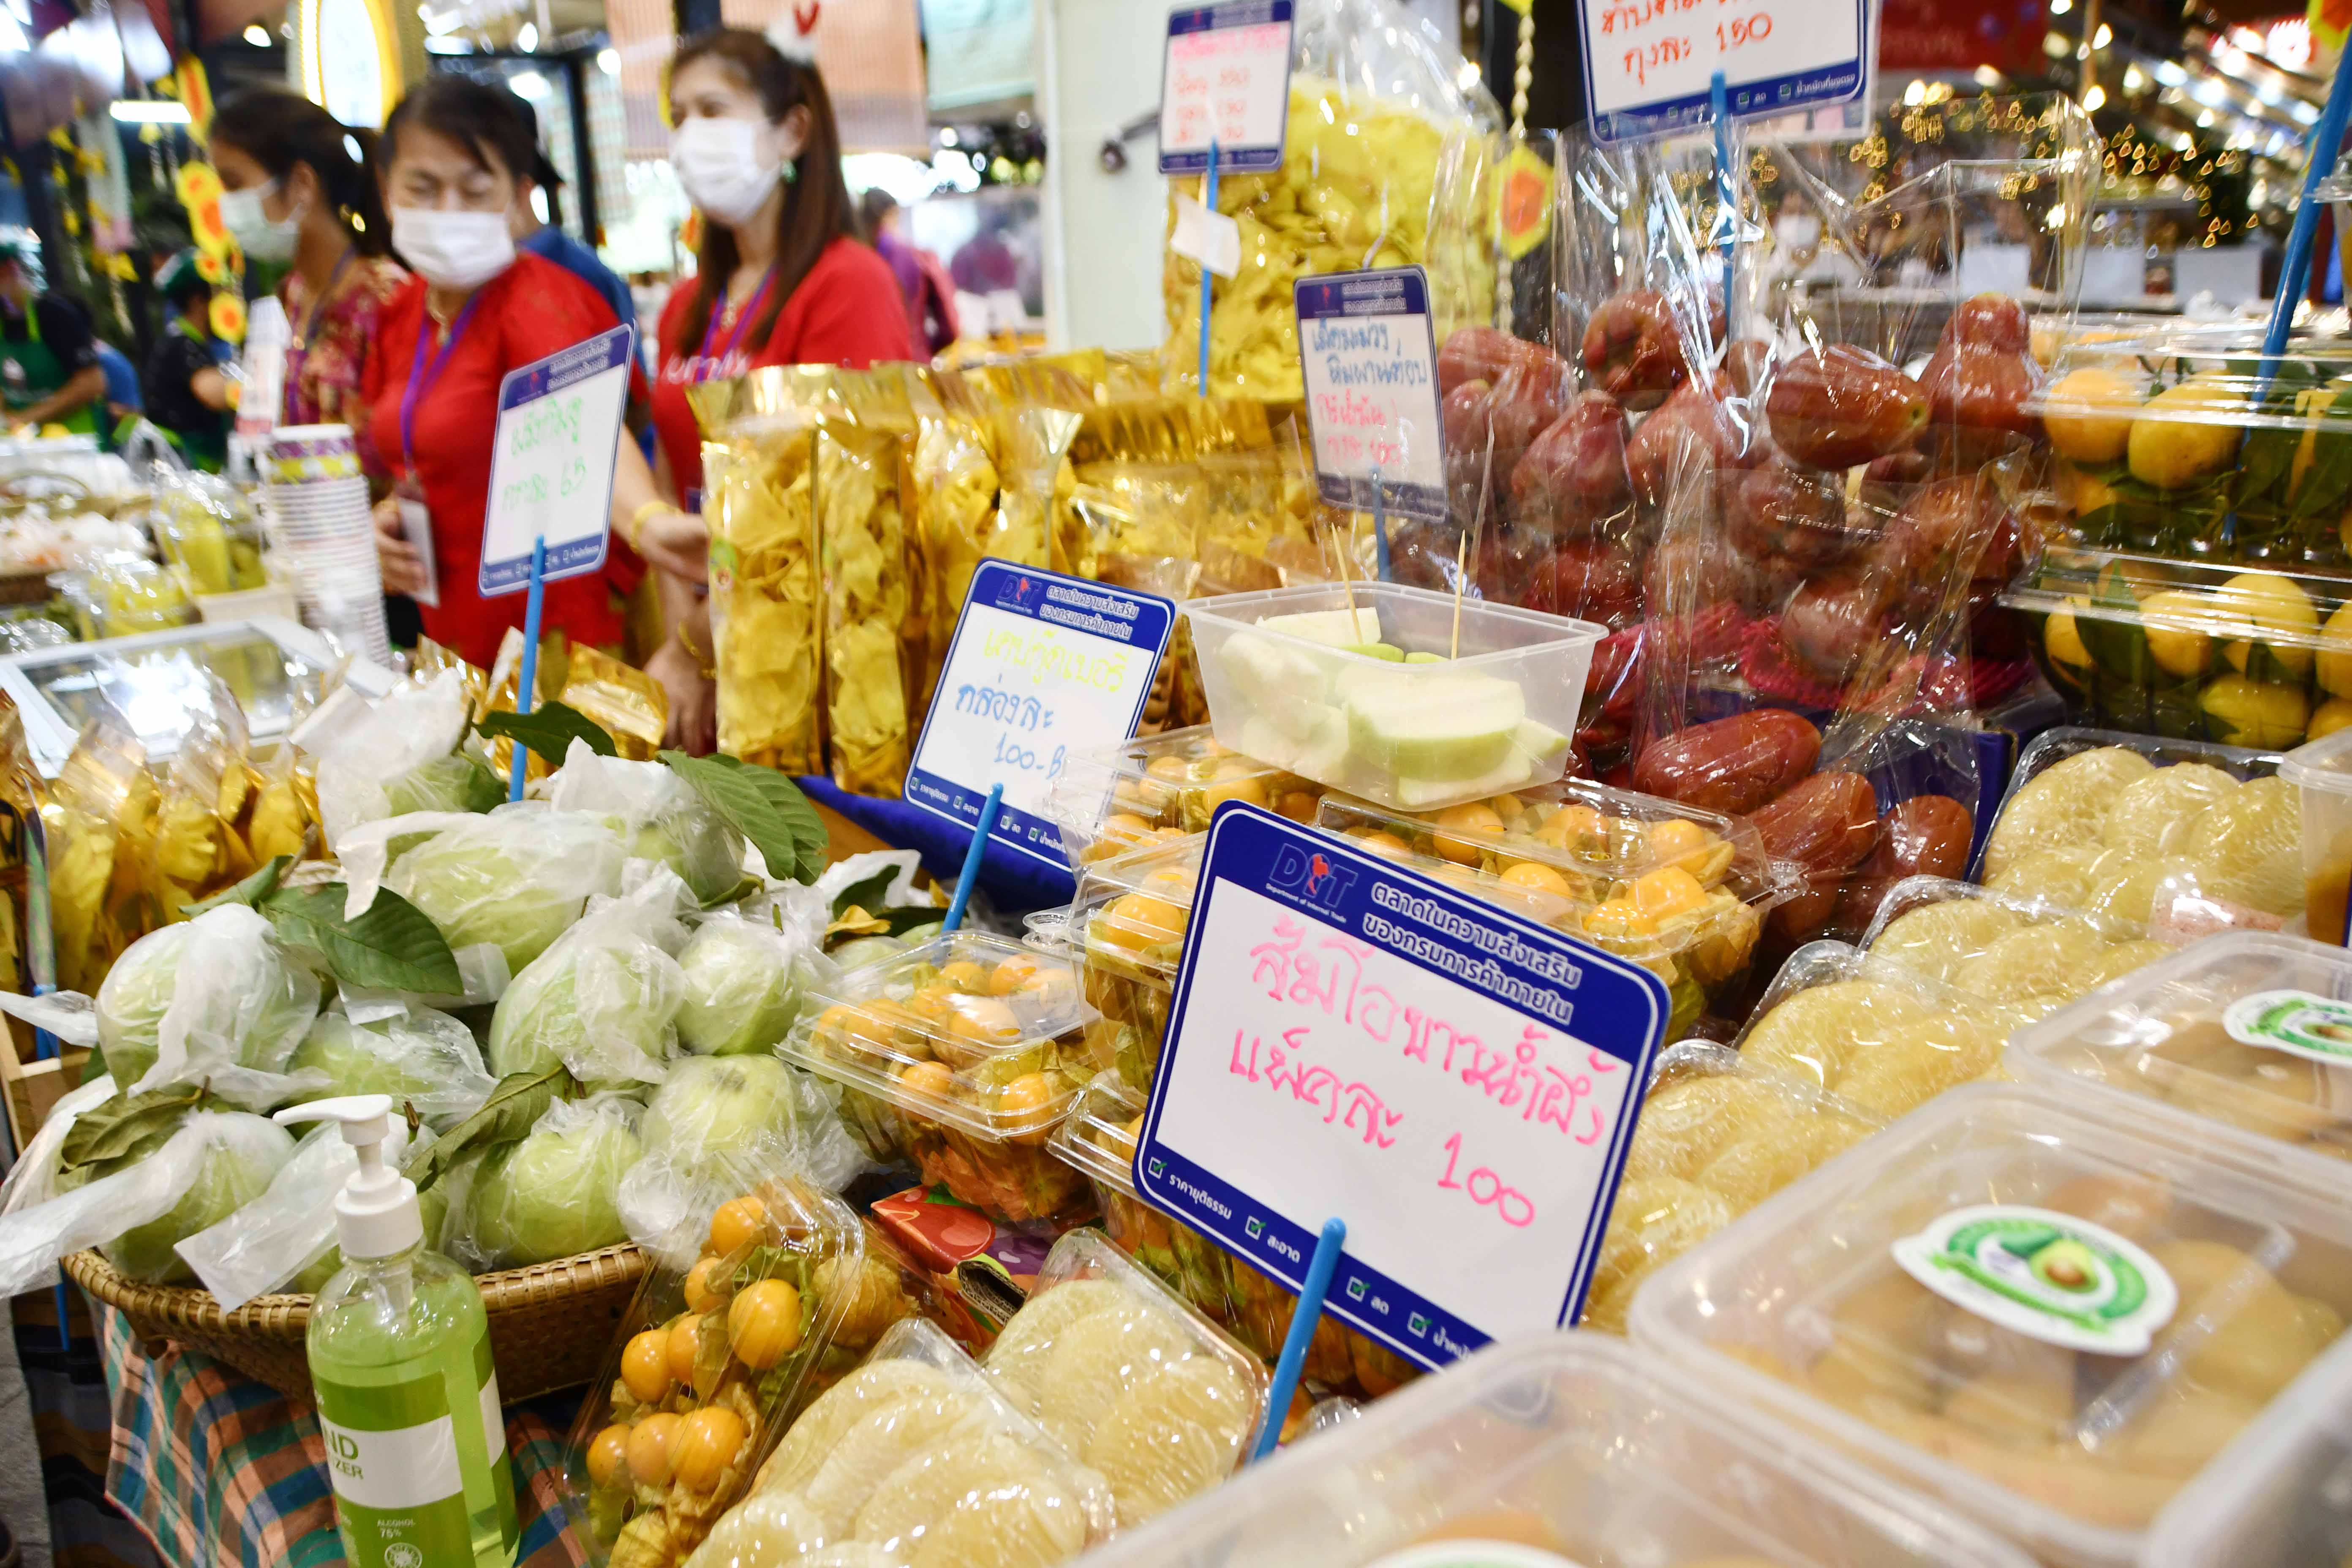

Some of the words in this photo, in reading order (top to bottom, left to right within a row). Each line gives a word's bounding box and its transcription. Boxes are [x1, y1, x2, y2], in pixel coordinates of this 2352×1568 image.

[1716, 12, 1772, 52] 150
[1039, 604, 1133, 641] ของกรมการค้าภายใน
[1046, 585, 1140, 621] ตลาดในความส่งเสริม
[955, 672, 1054, 731] กล่องละ
[1371, 882, 1583, 990] ตลาดในความส่งเสริม
[1362, 912, 1574, 1026] ของกรมการค้าภายใน
[1169, 1173, 1232, 1220] ราคายุติธรรม
[1437, 1130, 1535, 1228] 100
[1267, 1234, 1301, 1264] สะอาด
[1370, 1295, 1390, 1316] สด
[377, 1519, 416, 1528] ALCOHOL
